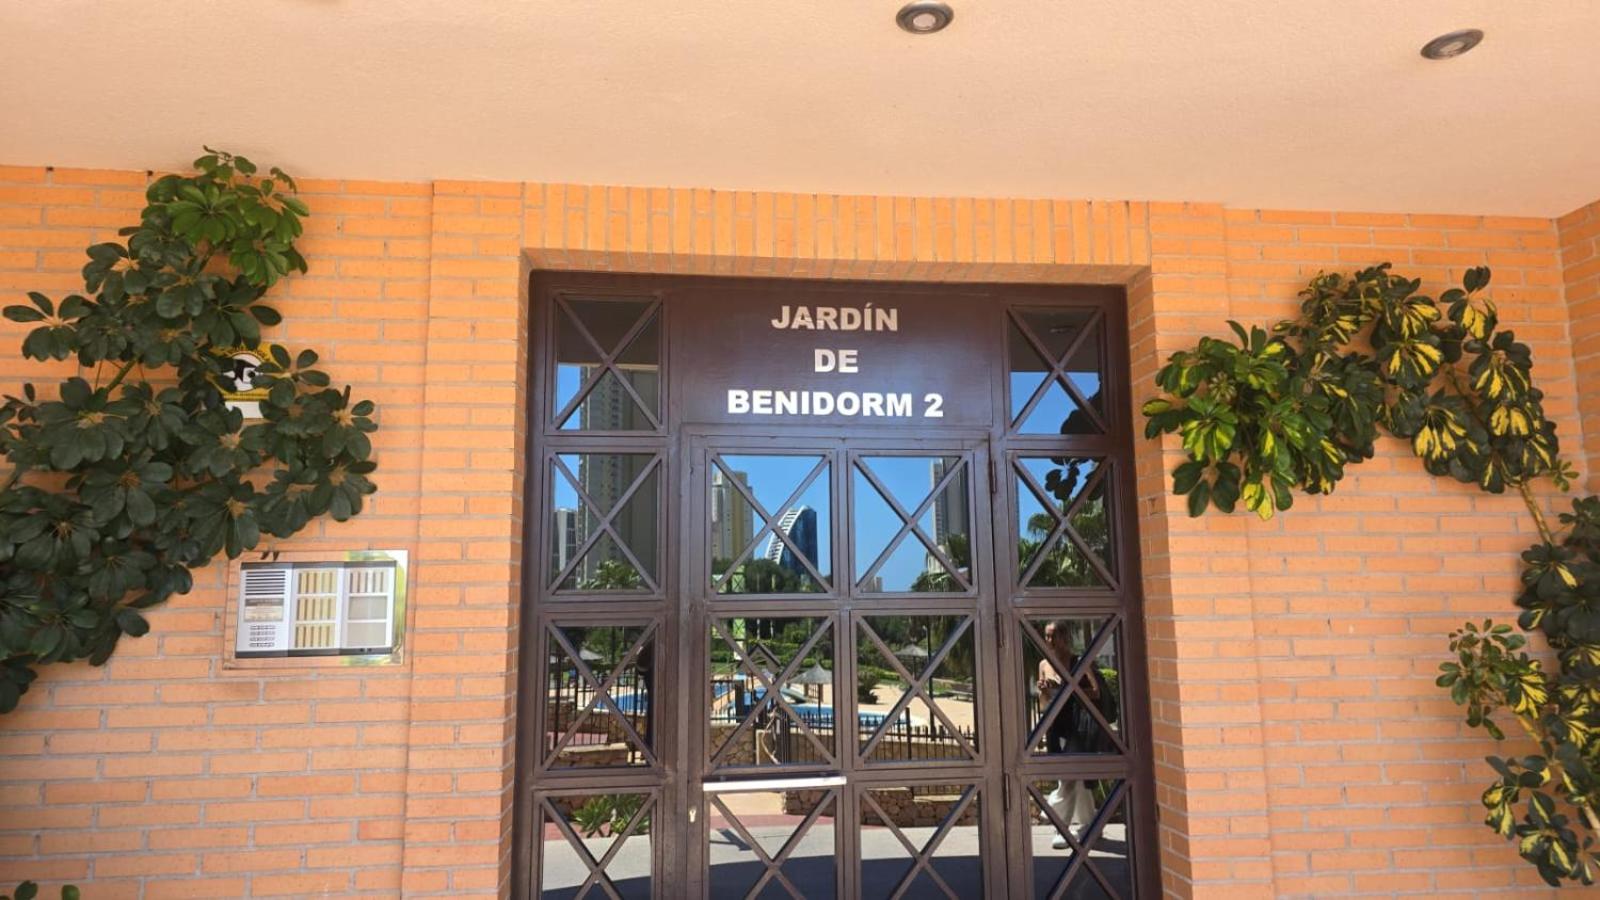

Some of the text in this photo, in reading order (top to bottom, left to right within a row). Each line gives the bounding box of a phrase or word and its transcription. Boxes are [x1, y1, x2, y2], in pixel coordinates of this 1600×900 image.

[771, 303, 898, 331] JARDÍN
[814, 349, 859, 373] DE
[727, 389, 944, 417] BENIDORM 2
